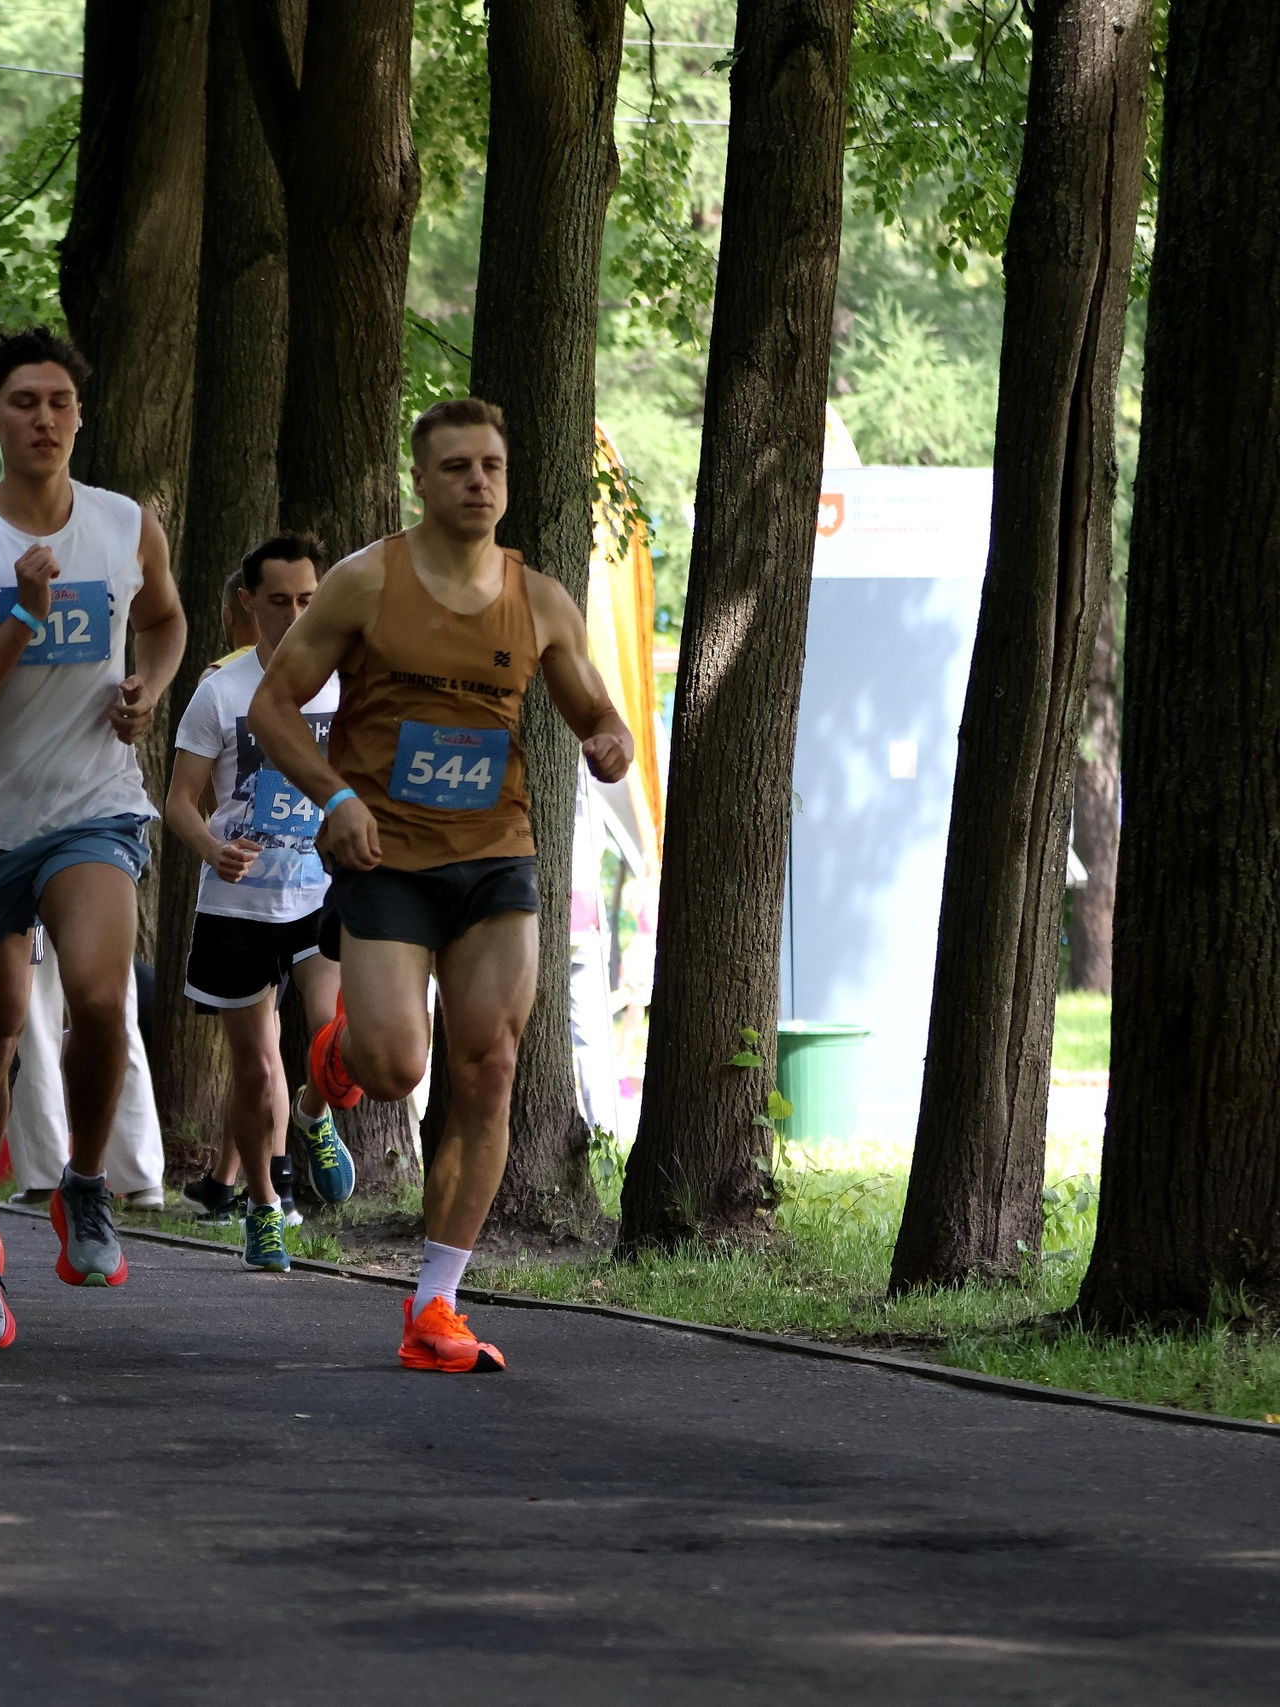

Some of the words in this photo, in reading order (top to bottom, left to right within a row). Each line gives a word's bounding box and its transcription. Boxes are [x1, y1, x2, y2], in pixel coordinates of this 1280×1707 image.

[450, 679, 458, 690] &
[407, 751, 491, 790] 544
[270, 793, 325, 821] 54
